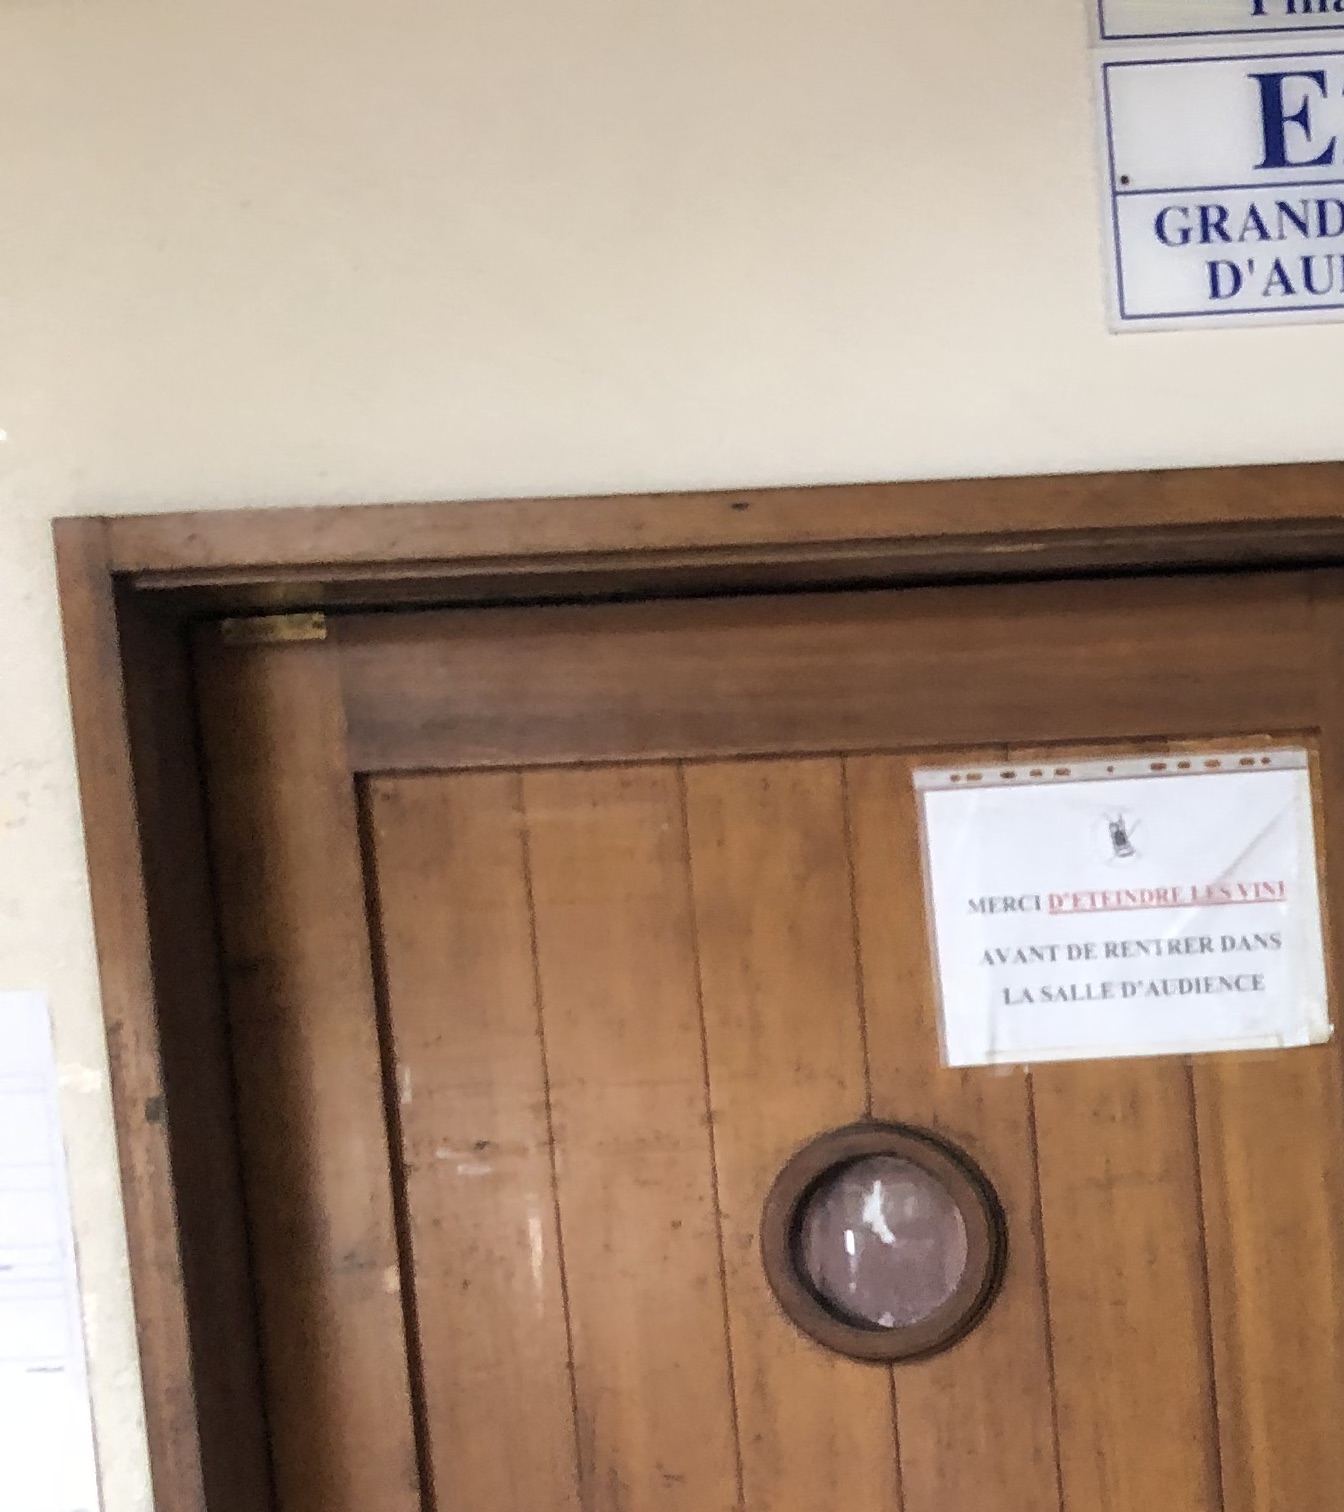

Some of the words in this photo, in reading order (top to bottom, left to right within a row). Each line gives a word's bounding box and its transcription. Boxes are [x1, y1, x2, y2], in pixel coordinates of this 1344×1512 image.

[967, 894, 1042, 915] MERCI
[1190, 884, 1233, 902] LES
[980, 944, 1061, 966] AVANT
[1066, 941, 1098, 962] DE
[1103, 935, 1214, 960] RENTRER
[1220, 931, 1284, 953] DANS
[1003, 986, 1035, 1006] LA
[1040, 980, 1115, 1004] SALLE
[1121, 972, 1266, 999] D'AUDIENCE
